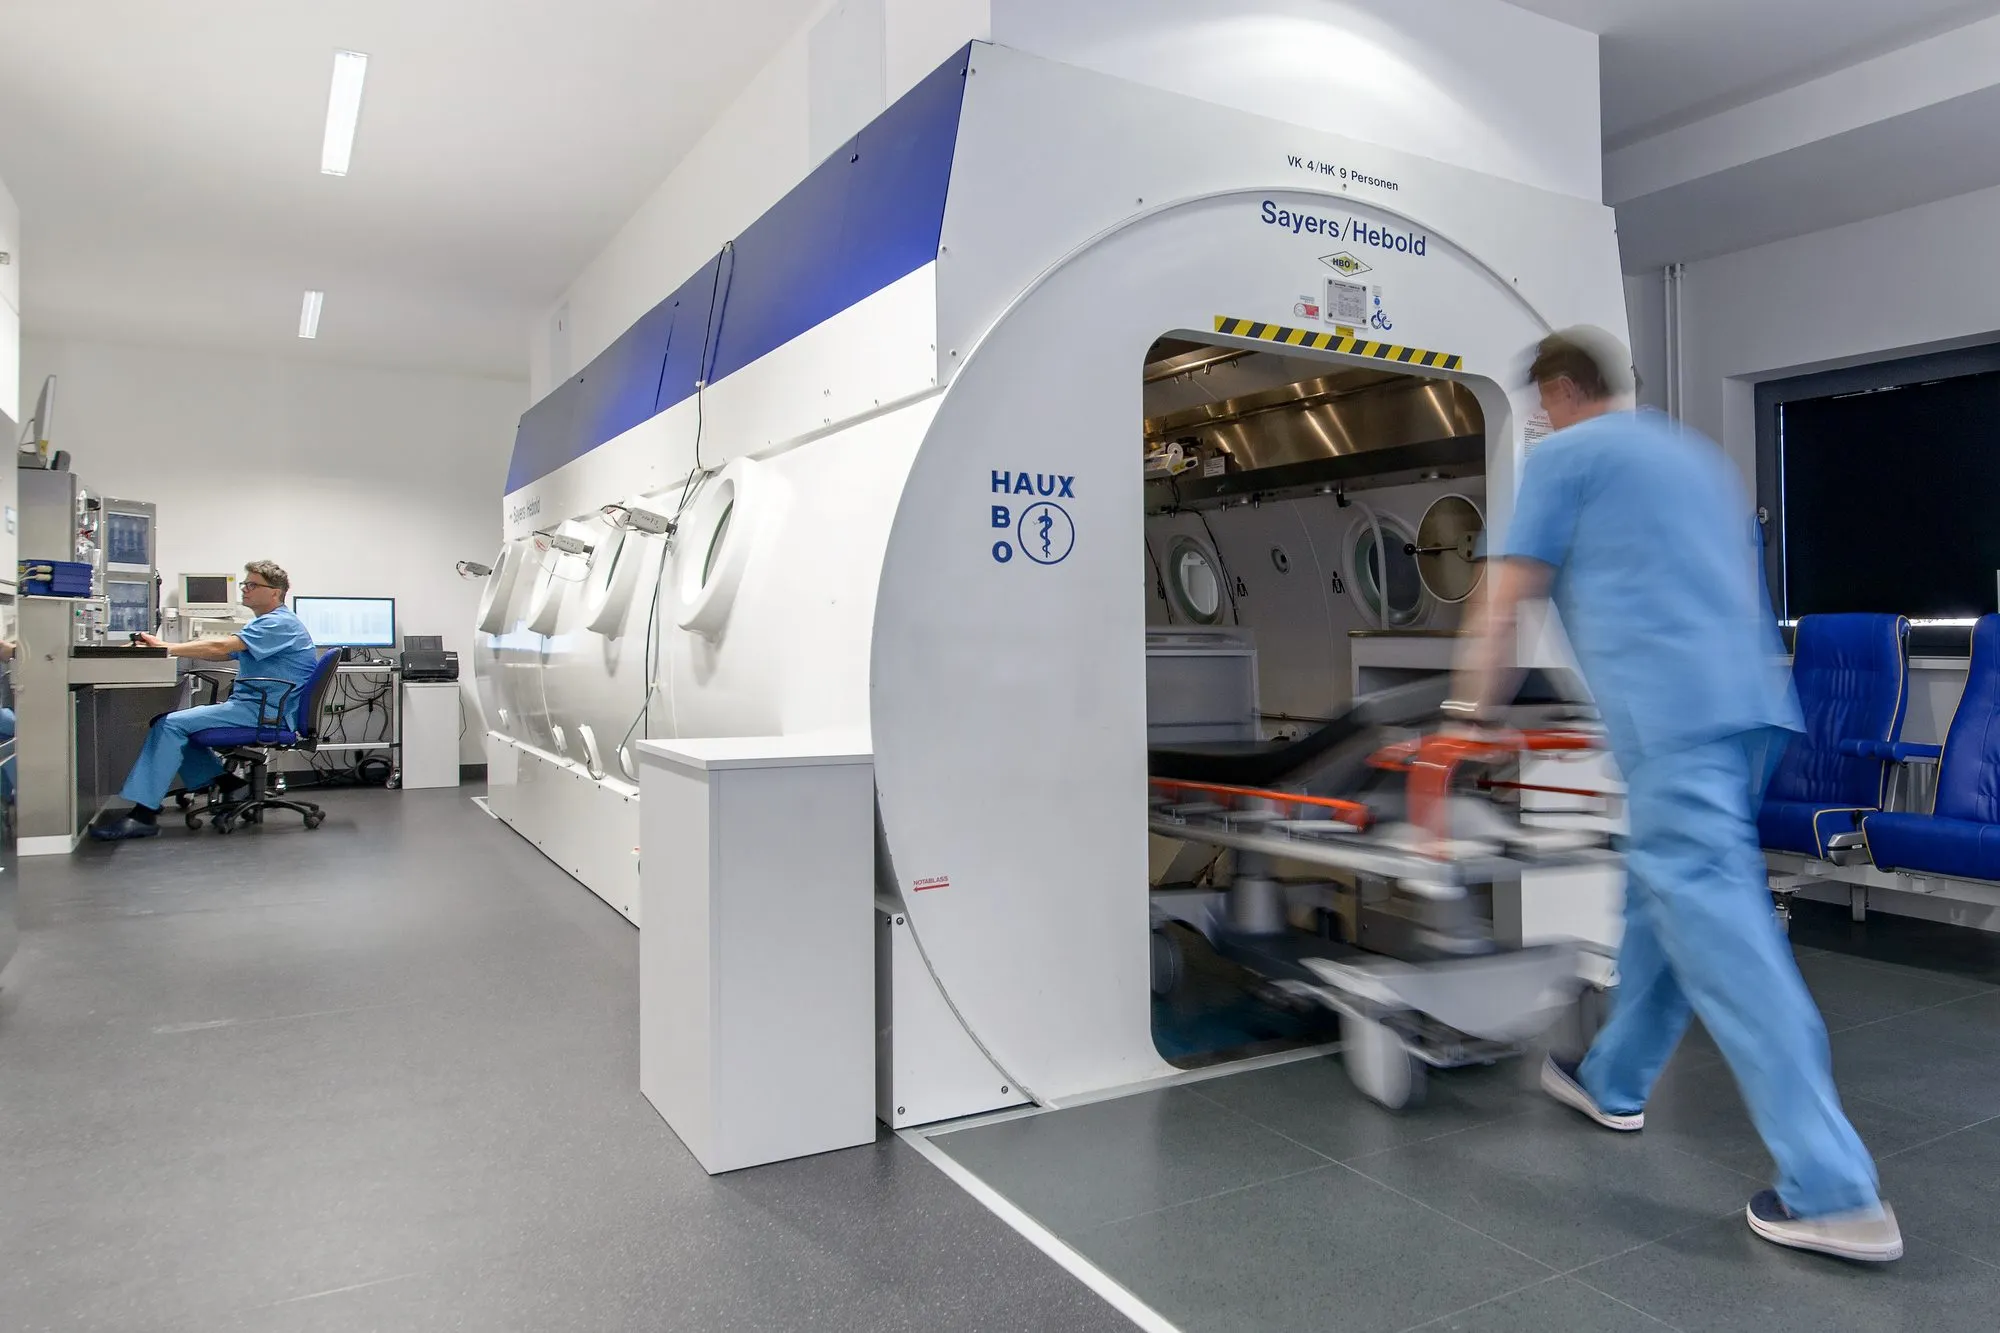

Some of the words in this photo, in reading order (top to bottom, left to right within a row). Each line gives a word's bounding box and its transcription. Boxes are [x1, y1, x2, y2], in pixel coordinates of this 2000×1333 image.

[1287, 154, 1303, 169] VK
[1307, 160, 1335, 176] 4/HK
[1339, 167, 1347, 179] 9
[1351, 170, 1399, 191] Personen
[1261, 200, 1426, 256] Sayers/Hebold
[1332, 257, 1351, 269] HBO
[991, 470, 1076, 499] HAUX
[912, 875, 948, 885] NOTABLASS
